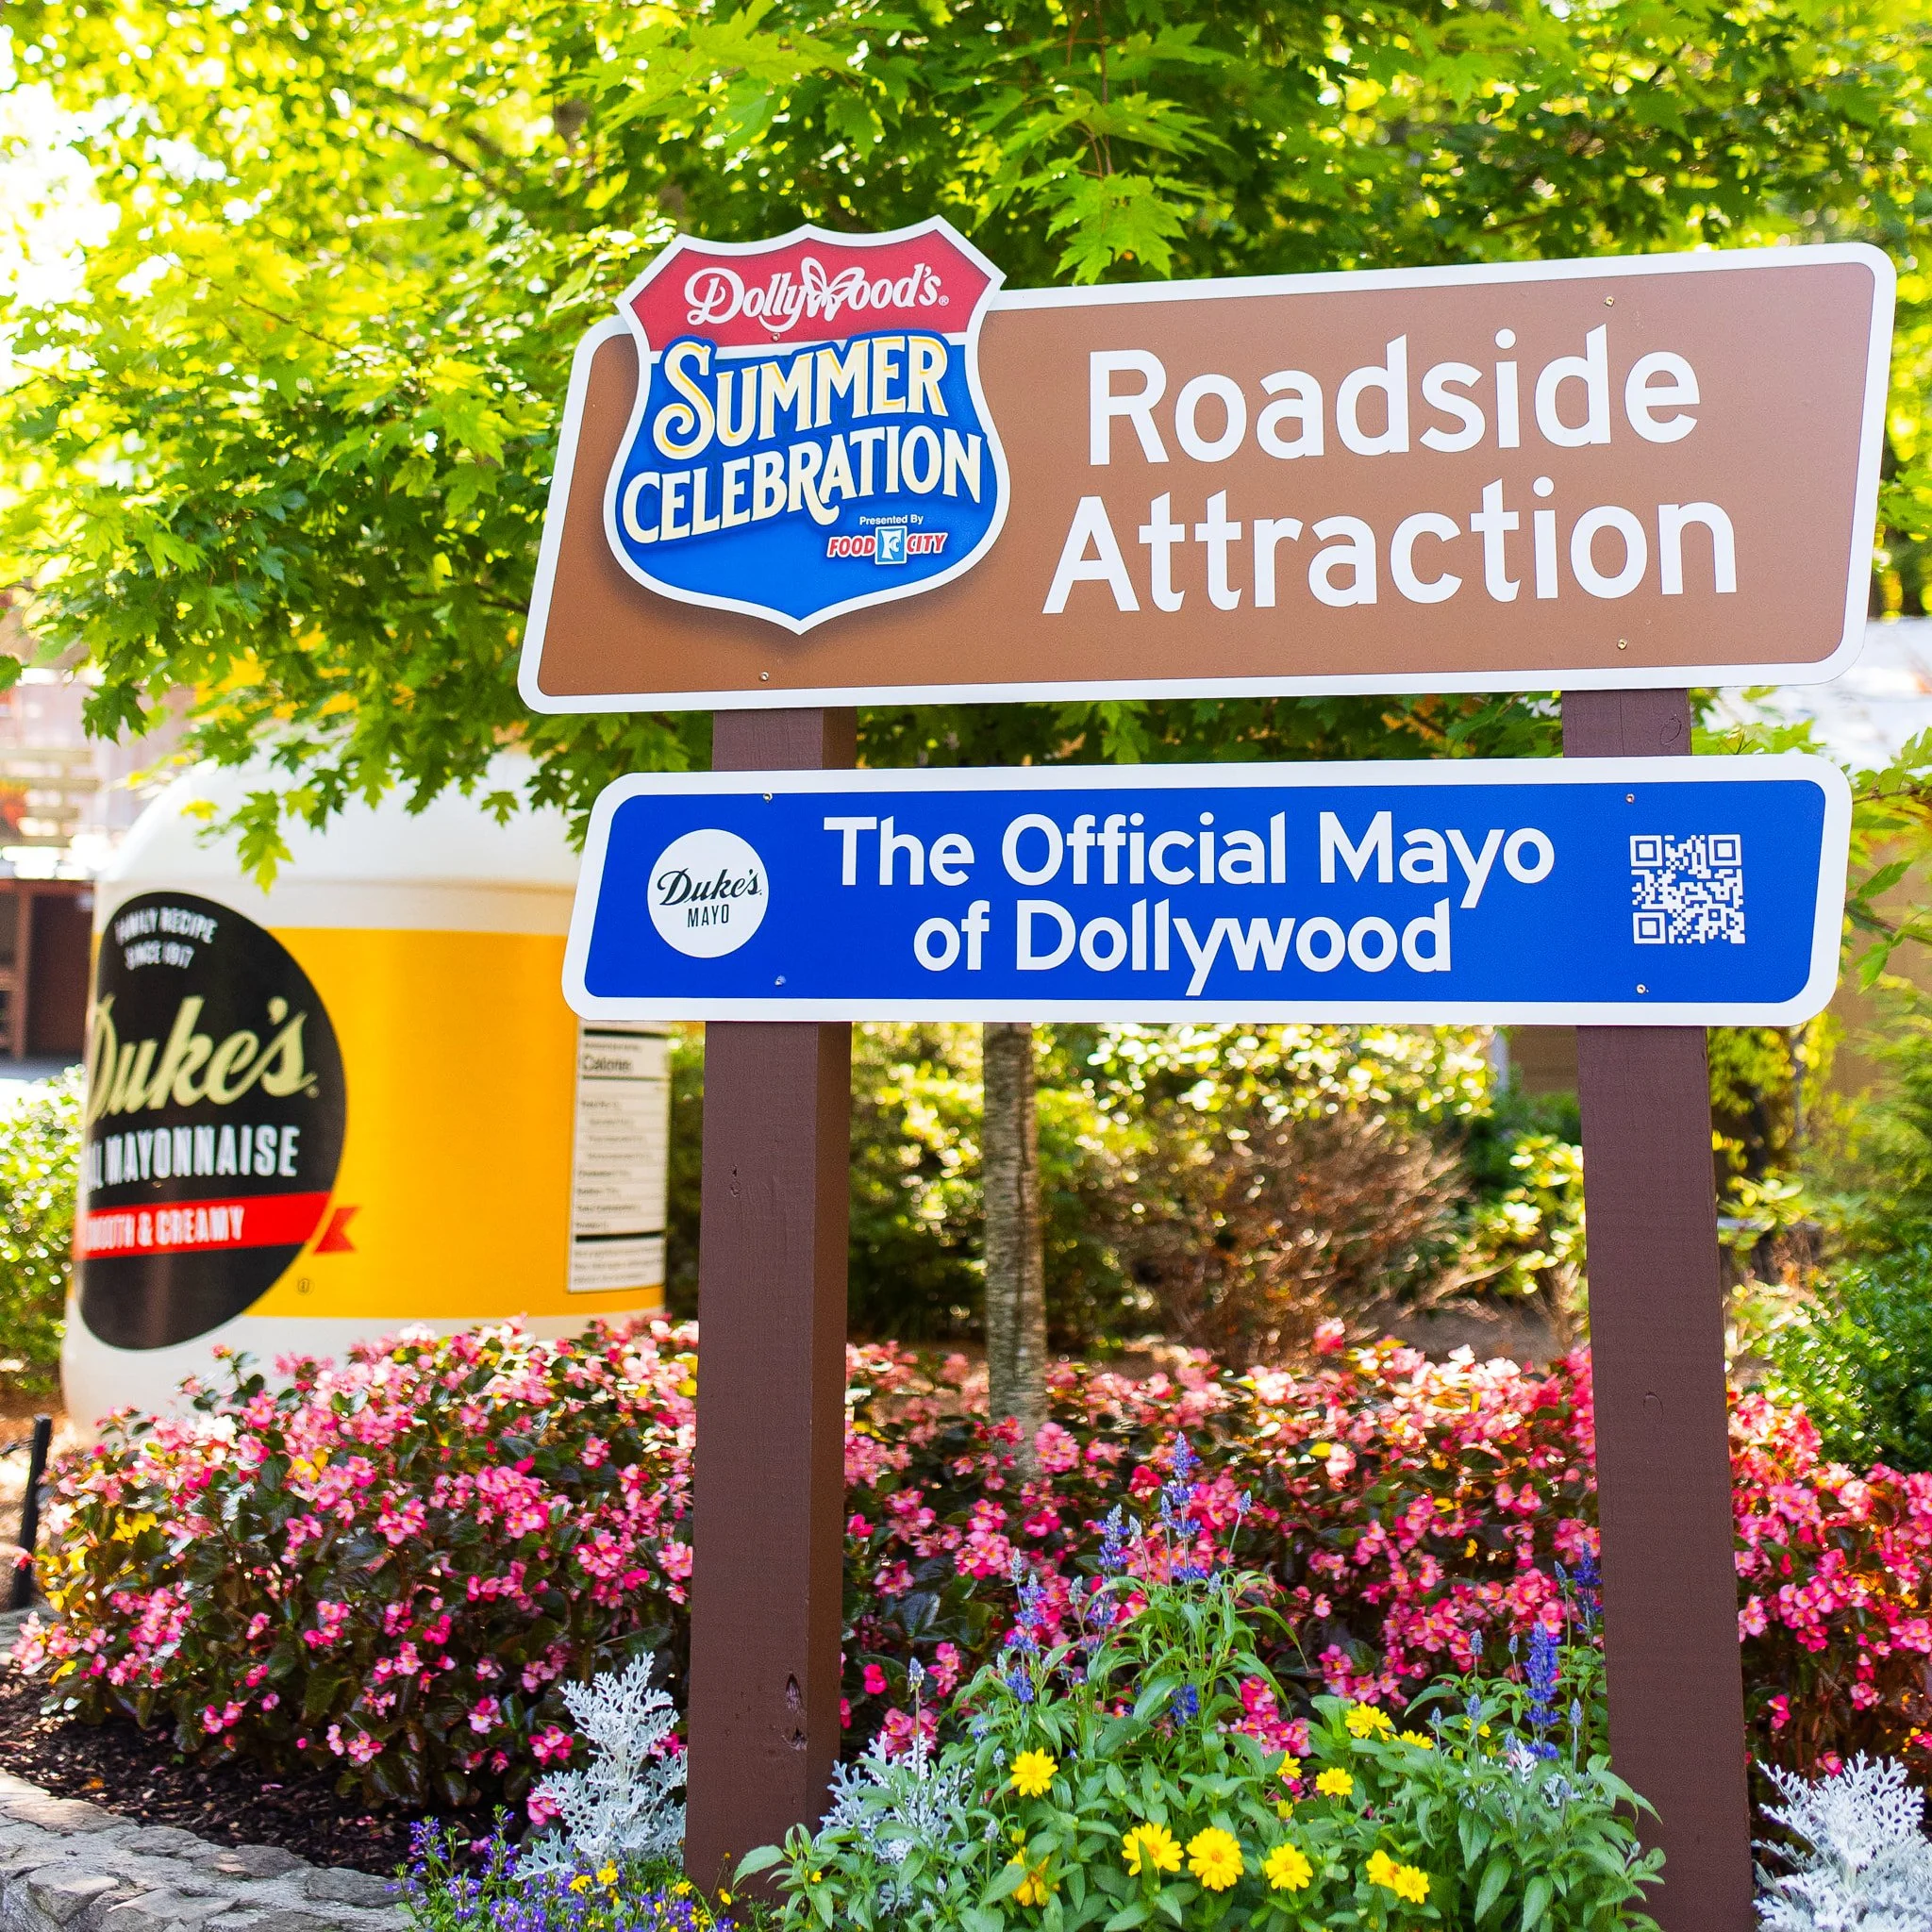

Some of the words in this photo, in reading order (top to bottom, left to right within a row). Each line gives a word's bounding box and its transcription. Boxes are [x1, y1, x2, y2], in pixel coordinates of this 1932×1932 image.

[653, 334, 949, 460] SUMMER
[1089, 324, 1701, 466] Roadside
[622, 424, 983, 545] CELEBRATION
[827, 535, 875, 558] FOOD
[906, 532, 948, 555] CITY
[859, 515, 908, 525] Presented
[910, 513, 924, 525] By
[1041, 475, 1738, 614] Attraction
[657, 867, 762, 906] Duke's
[824, 815, 975, 887] The
[1001, 810, 1286, 886] Official
[1320, 810, 1556, 909] Mayo
[158, 906, 218, 943] RECIPE
[687, 904, 729, 927] MAYO
[913, 900, 991, 972] of
[1015, 896, 1452, 996] Dollywood
[105, 1124, 300, 1187] MAYONNAISE
[155, 1205, 244, 1245] CREAMY
